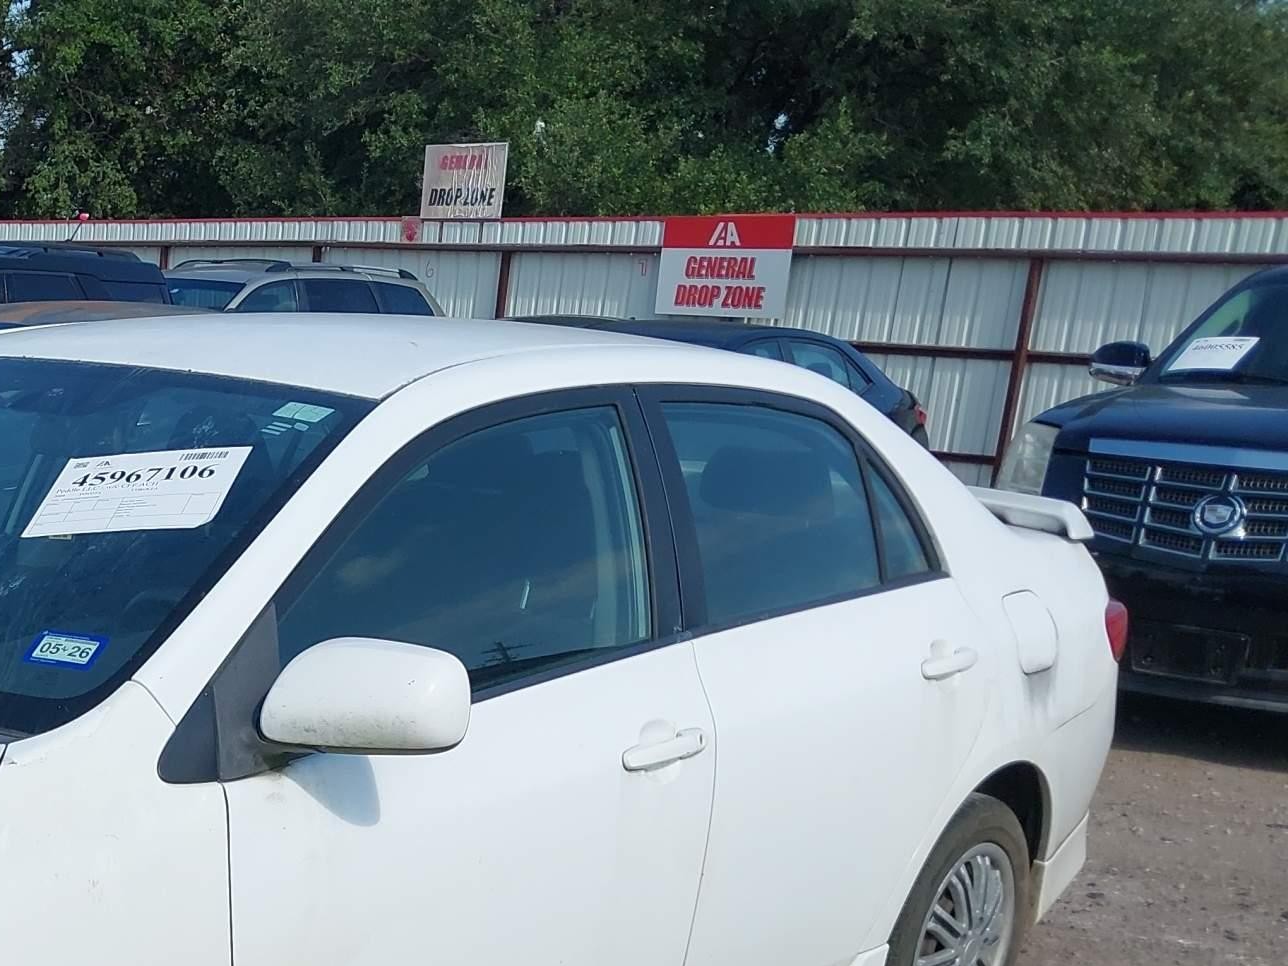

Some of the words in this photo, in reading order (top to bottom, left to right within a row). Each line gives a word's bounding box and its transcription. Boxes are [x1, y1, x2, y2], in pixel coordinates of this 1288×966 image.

[428, 188, 463, 207] DROP
[463, 188, 496, 207] ZONE
[685, 256, 756, 280] GENERAL
[674, 284, 721, 308] DROP
[721, 286, 766, 309] ZONE
[72, 463, 218, 488] 45967106
